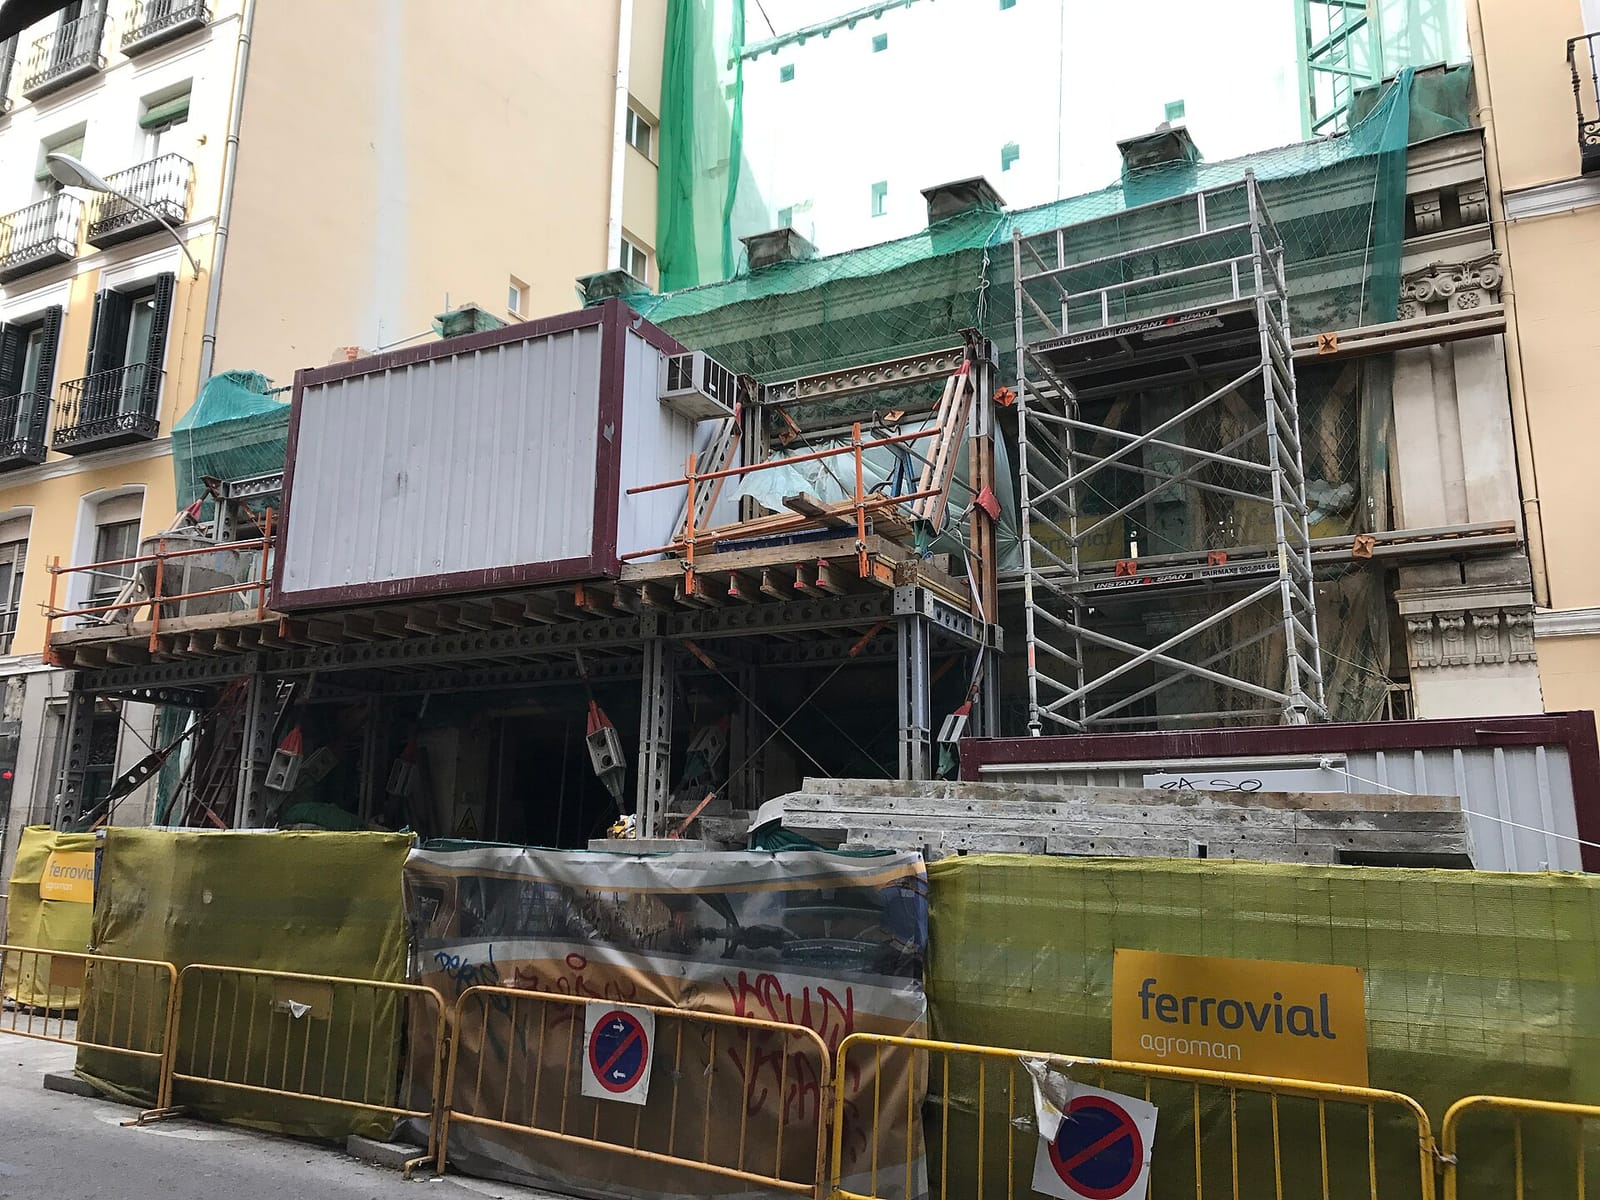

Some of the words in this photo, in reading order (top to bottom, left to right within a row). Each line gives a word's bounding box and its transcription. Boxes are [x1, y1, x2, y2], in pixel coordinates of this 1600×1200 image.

[1118, 319, 1165, 335] INSTANT
[1096, 578, 1143, 589] INSTANT
[1156, 573, 1188, 583] SPAN
[1138, 977, 1337, 1040] ferrovial
[1140, 1033, 1241, 1061] agroman
